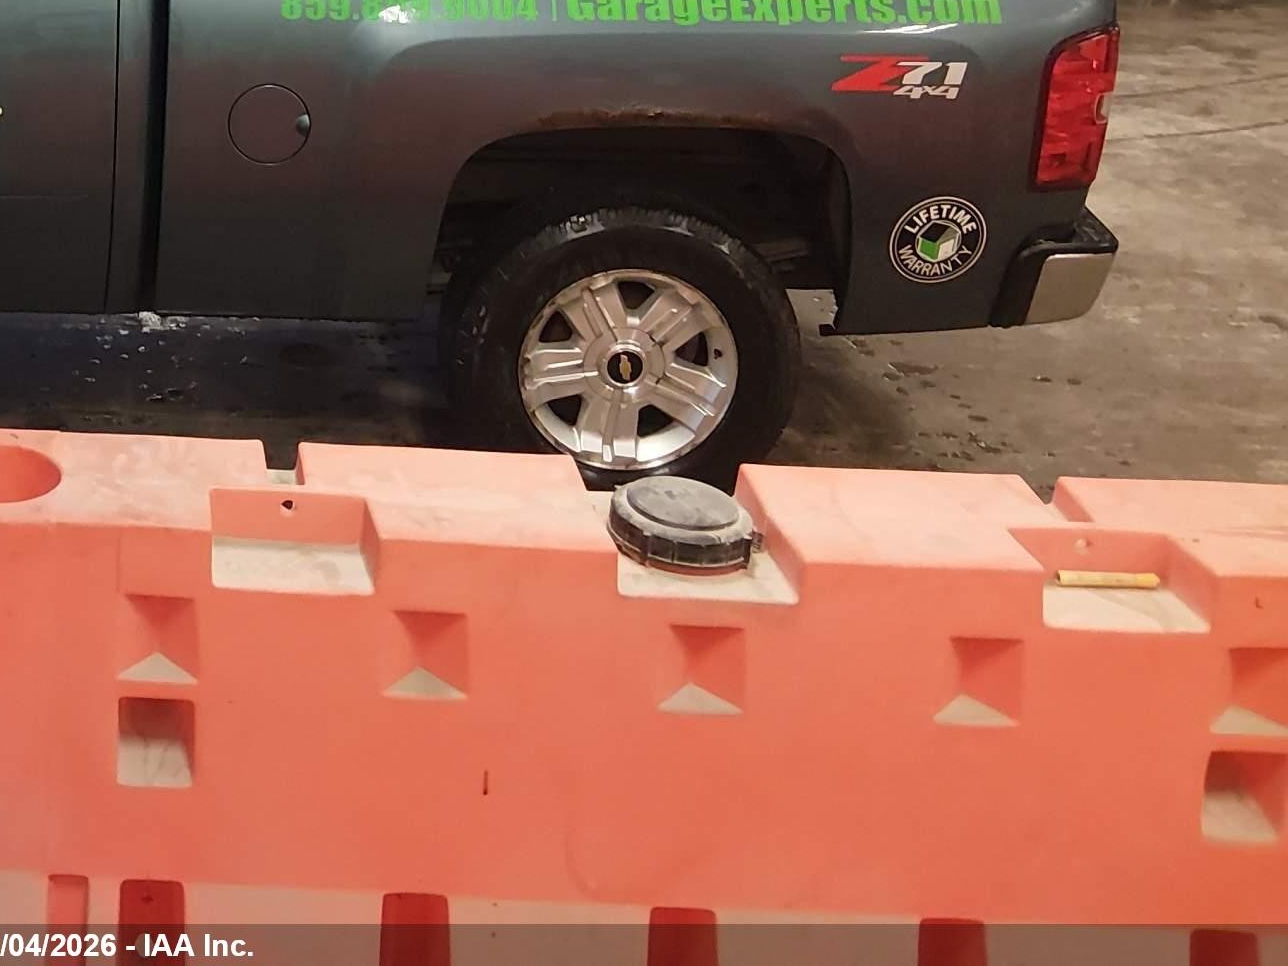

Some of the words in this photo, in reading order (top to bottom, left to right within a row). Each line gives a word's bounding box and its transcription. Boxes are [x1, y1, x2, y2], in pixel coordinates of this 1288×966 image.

[831, 54, 968, 91] Z71
[904, 204, 977, 234] LIFETIME
[898, 244, 972, 276] WARRANTY
